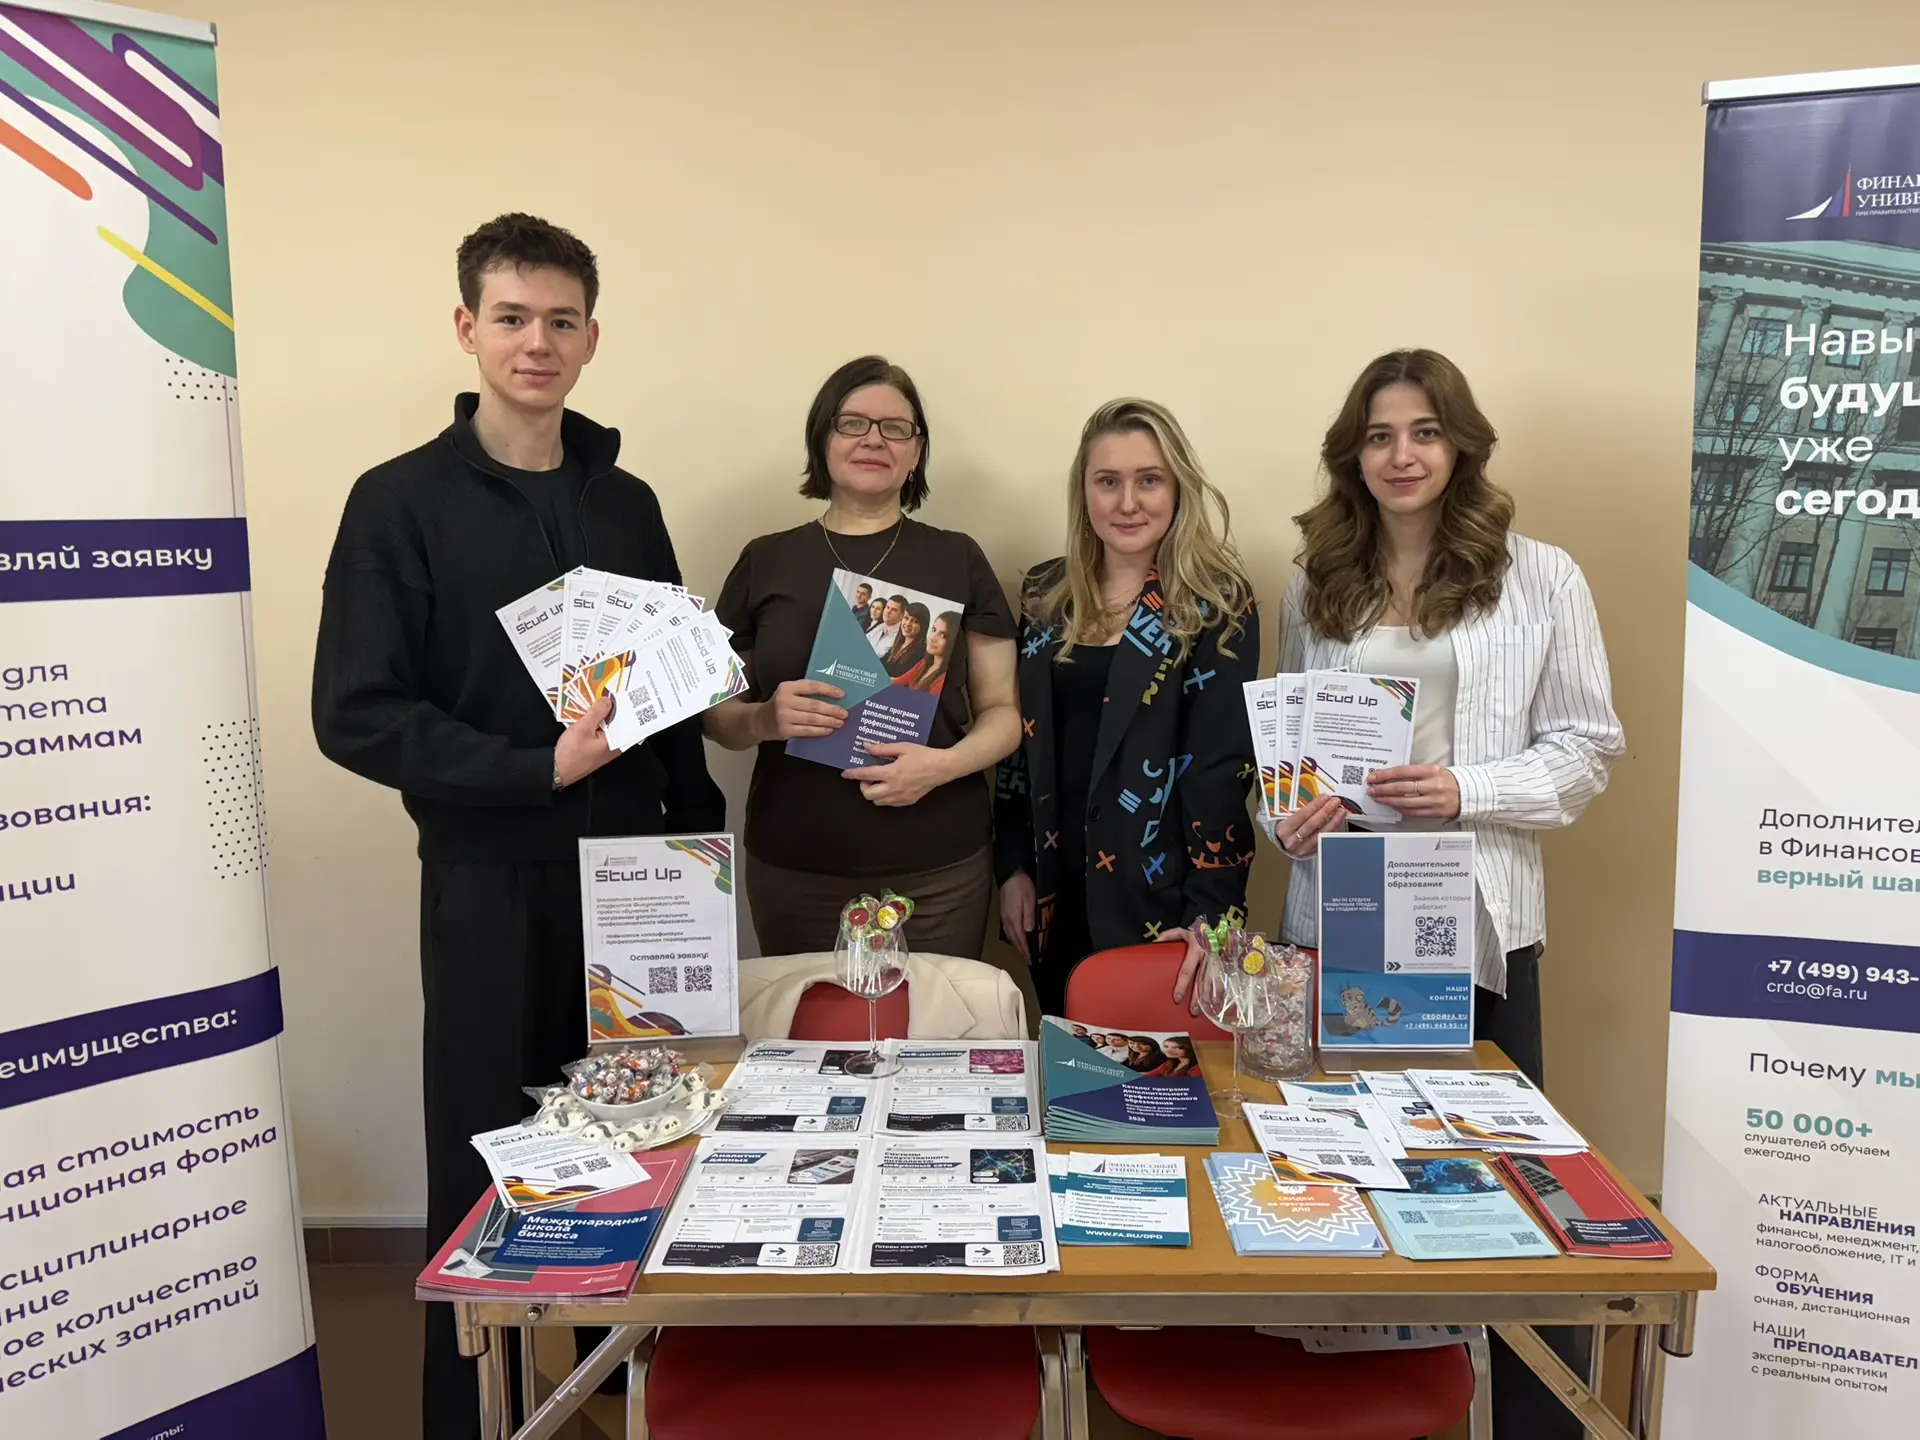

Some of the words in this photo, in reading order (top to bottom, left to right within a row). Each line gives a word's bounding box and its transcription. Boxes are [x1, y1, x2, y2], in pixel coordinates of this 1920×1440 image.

[1785, 323, 1913, 356] Навы
[1777, 434, 1874, 470] уже
[1775, 488, 1920, 519] сегод
[92, 547, 213, 571] заявку
[515, 612, 549, 635] Stud
[690, 626, 710, 661] Stud
[704, 659, 717, 675] Up
[2, 663, 69, 691] для
[865, 700, 889, 712] Каталог
[889, 707, 919, 720] программ
[1316, 692, 1354, 704] Stud
[1358, 695, 1378, 707] Up
[860, 717, 919, 738] профессионального
[862, 709, 915, 728] дополнительного
[858, 725, 897, 740] образования
[849, 755, 864, 766] 2026
[1760, 841, 1772, 855] в
[595, 868, 647, 882] Stud
[655, 868, 682, 882] Up
[1387, 860, 1460, 870] Дополнительное
[1387, 870, 1469, 880] профессиональное
[0, 873, 76, 901] ции
[1387, 880, 1443, 889] образование
[1757, 869, 1864, 889] верный
[1413, 903, 1447, 911] работают
[629, 953, 675, 961] Оставляй
[1767, 959, 1792, 975] +7
[1797, 961, 1859, 984] (499)
[1445, 985, 1468, 993] НАШИ
[1766, 980, 1868, 1001] crdo@fa.ru
[0, 1008, 238, 1079] еимущества:
[1749, 1052, 1867, 1088] Почему
[1875, 1069, 1920, 1088] мы
[1121, 1083, 1150, 1091] Каталог
[1259, 1114, 1300, 1122] Stud
[1746, 1107, 1784, 1130] 50
[1792, 1112, 1873, 1138] 000+
[0, 1164, 46, 1190] ая
[57, 1104, 260, 1173] стоимость
[177, 1125, 278, 1175] форма
[490, 1134, 533, 1147] Stud
[1744, 1133, 1827, 1151] слушателей
[1830, 1143, 1890, 1158] обучаем
[1744, 1147, 1811, 1163] ежегодно
[1758, 1193, 1878, 1219] АКТУАЛЬНЫЕ
[522, 1224, 571, 1232] школа
[526, 1215, 648, 1227] Международная
[1779, 1209, 1916, 1237] НАПРАВЛЕНИЯ
[0, 1199, 248, 1290] сциплинарное
[517, 1230, 579, 1240] бизнеса
[1085, 1229, 1163, 1240] WWW.FA.RU/DPO
[1756, 1222, 1823, 1242] финансы,
[1827, 1233, 1919, 1254] менеджмент,
[1756, 1238, 1886, 1264] налогообложение,
[1907, 1258, 1916, 1267] и
[1755, 1264, 1820, 1285] ФОРМА
[1775, 1281, 1874, 1305] ОБУЧЕНИЯ
[0, 1331, 45, 1358] ое
[56, 1254, 258, 1338] количество
[0, 1289, 70, 1326] ние
[1753, 1295, 1798, 1312] очная,
[1801, 1300, 1910, 1325] дистанционная
[0, 1339, 107, 1393] еских
[116, 1279, 260, 1349] занятий
[1752, 1321, 1806, 1339] НАШИ
[1751, 1351, 1888, 1379] эксперты-практики
[1773, 1337, 1918, 1370] ПРЕПОДАВАТЕЛ
[1751, 1365, 1759, 1374] с
[1762, 1366, 1831, 1385] реальным
[1834, 1376, 1888, 1394] опытом
